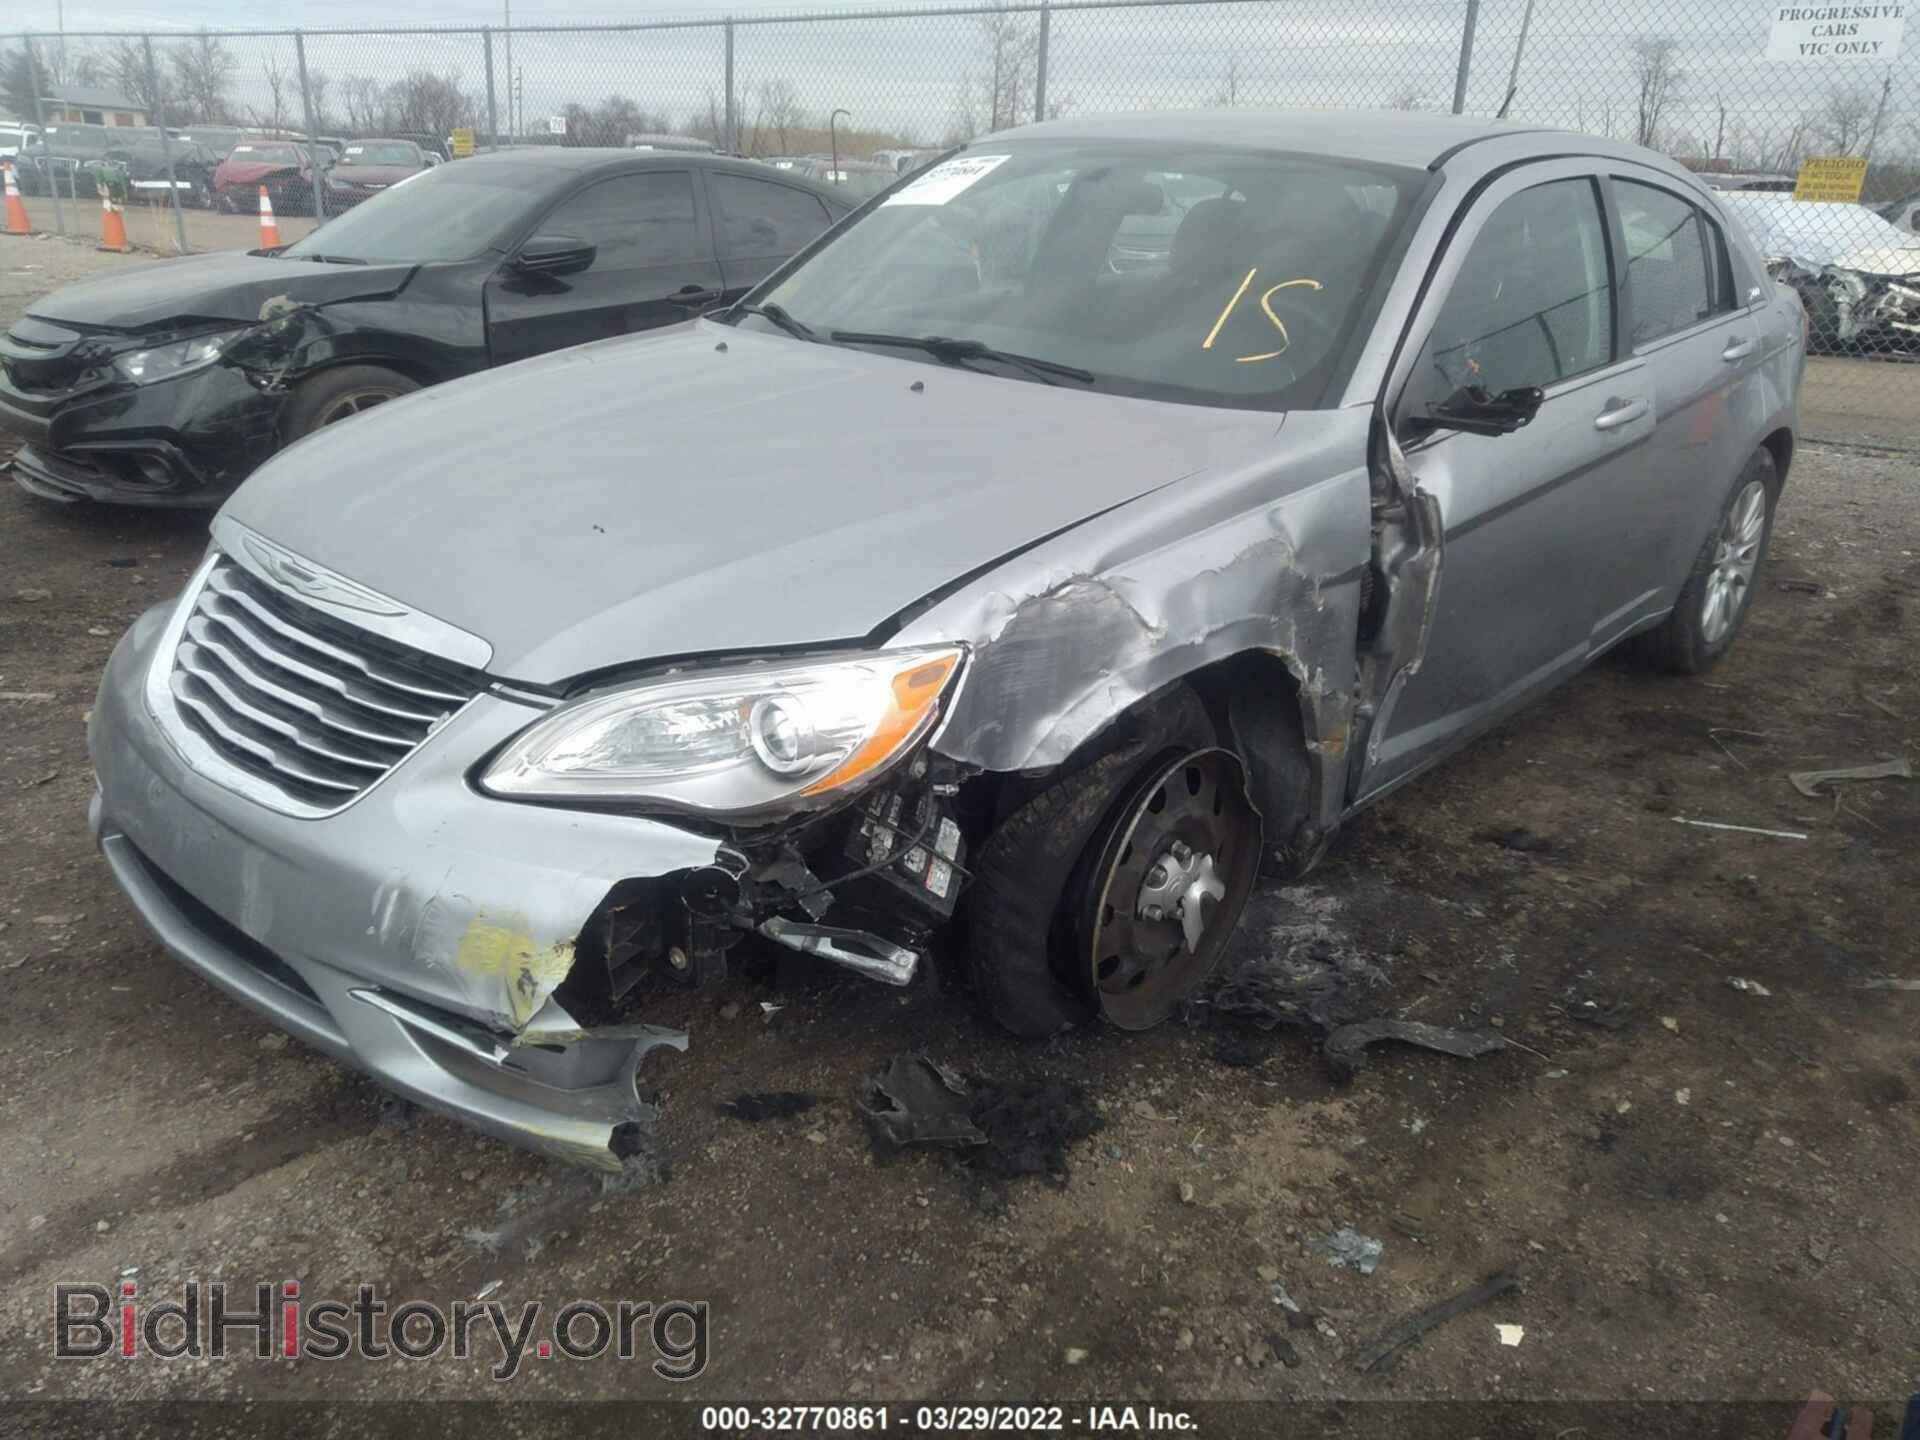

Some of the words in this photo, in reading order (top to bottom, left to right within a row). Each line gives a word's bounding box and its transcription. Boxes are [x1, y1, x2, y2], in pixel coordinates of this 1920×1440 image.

[1778, 6, 1905, 21] PROGRESSIVE
[1811, 24, 1859, 37] CARS
[1799, 43, 1830, 56] VIC
[1834, 41, 1883, 55] ONLY
